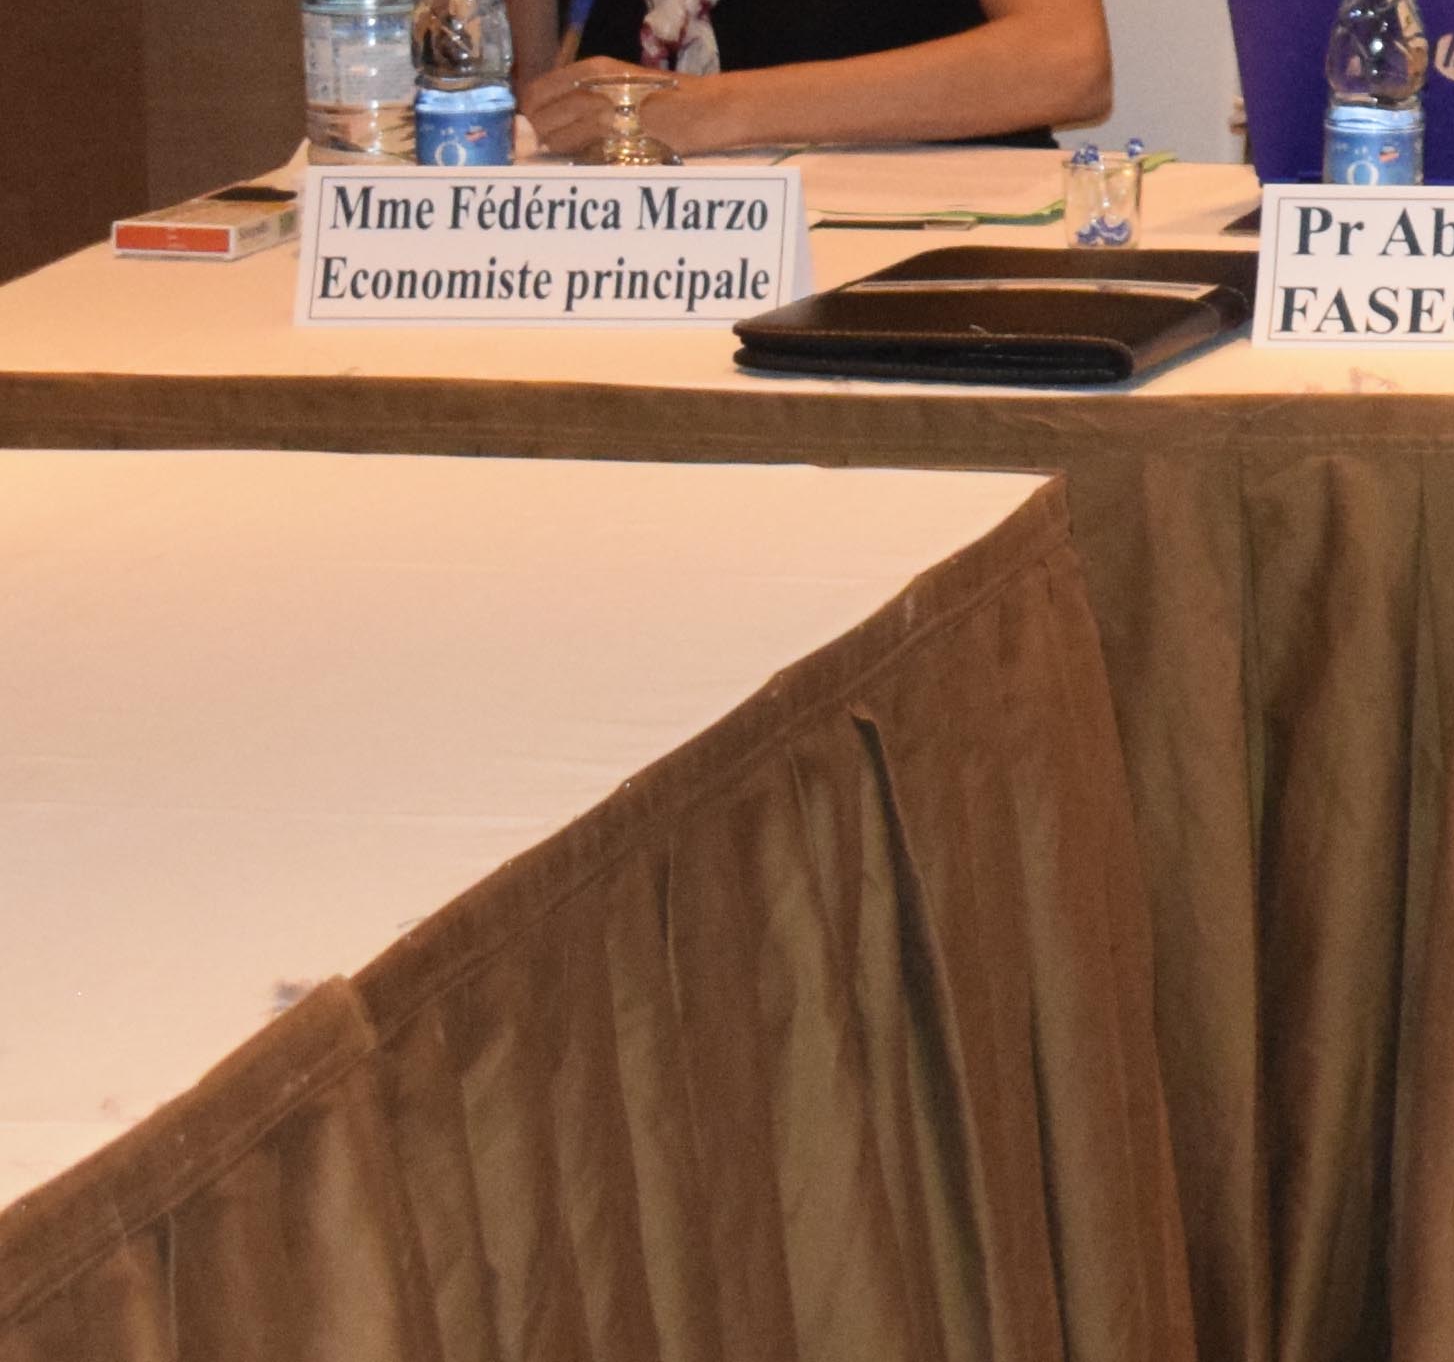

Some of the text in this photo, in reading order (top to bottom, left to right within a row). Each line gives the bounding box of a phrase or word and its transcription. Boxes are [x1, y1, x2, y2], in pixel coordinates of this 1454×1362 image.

[331, 183, 769, 232] Mme Fédérica Marzo
[1295, 205, 1366, 257] Pr
[318, 255, 770, 313] Economiste principale
